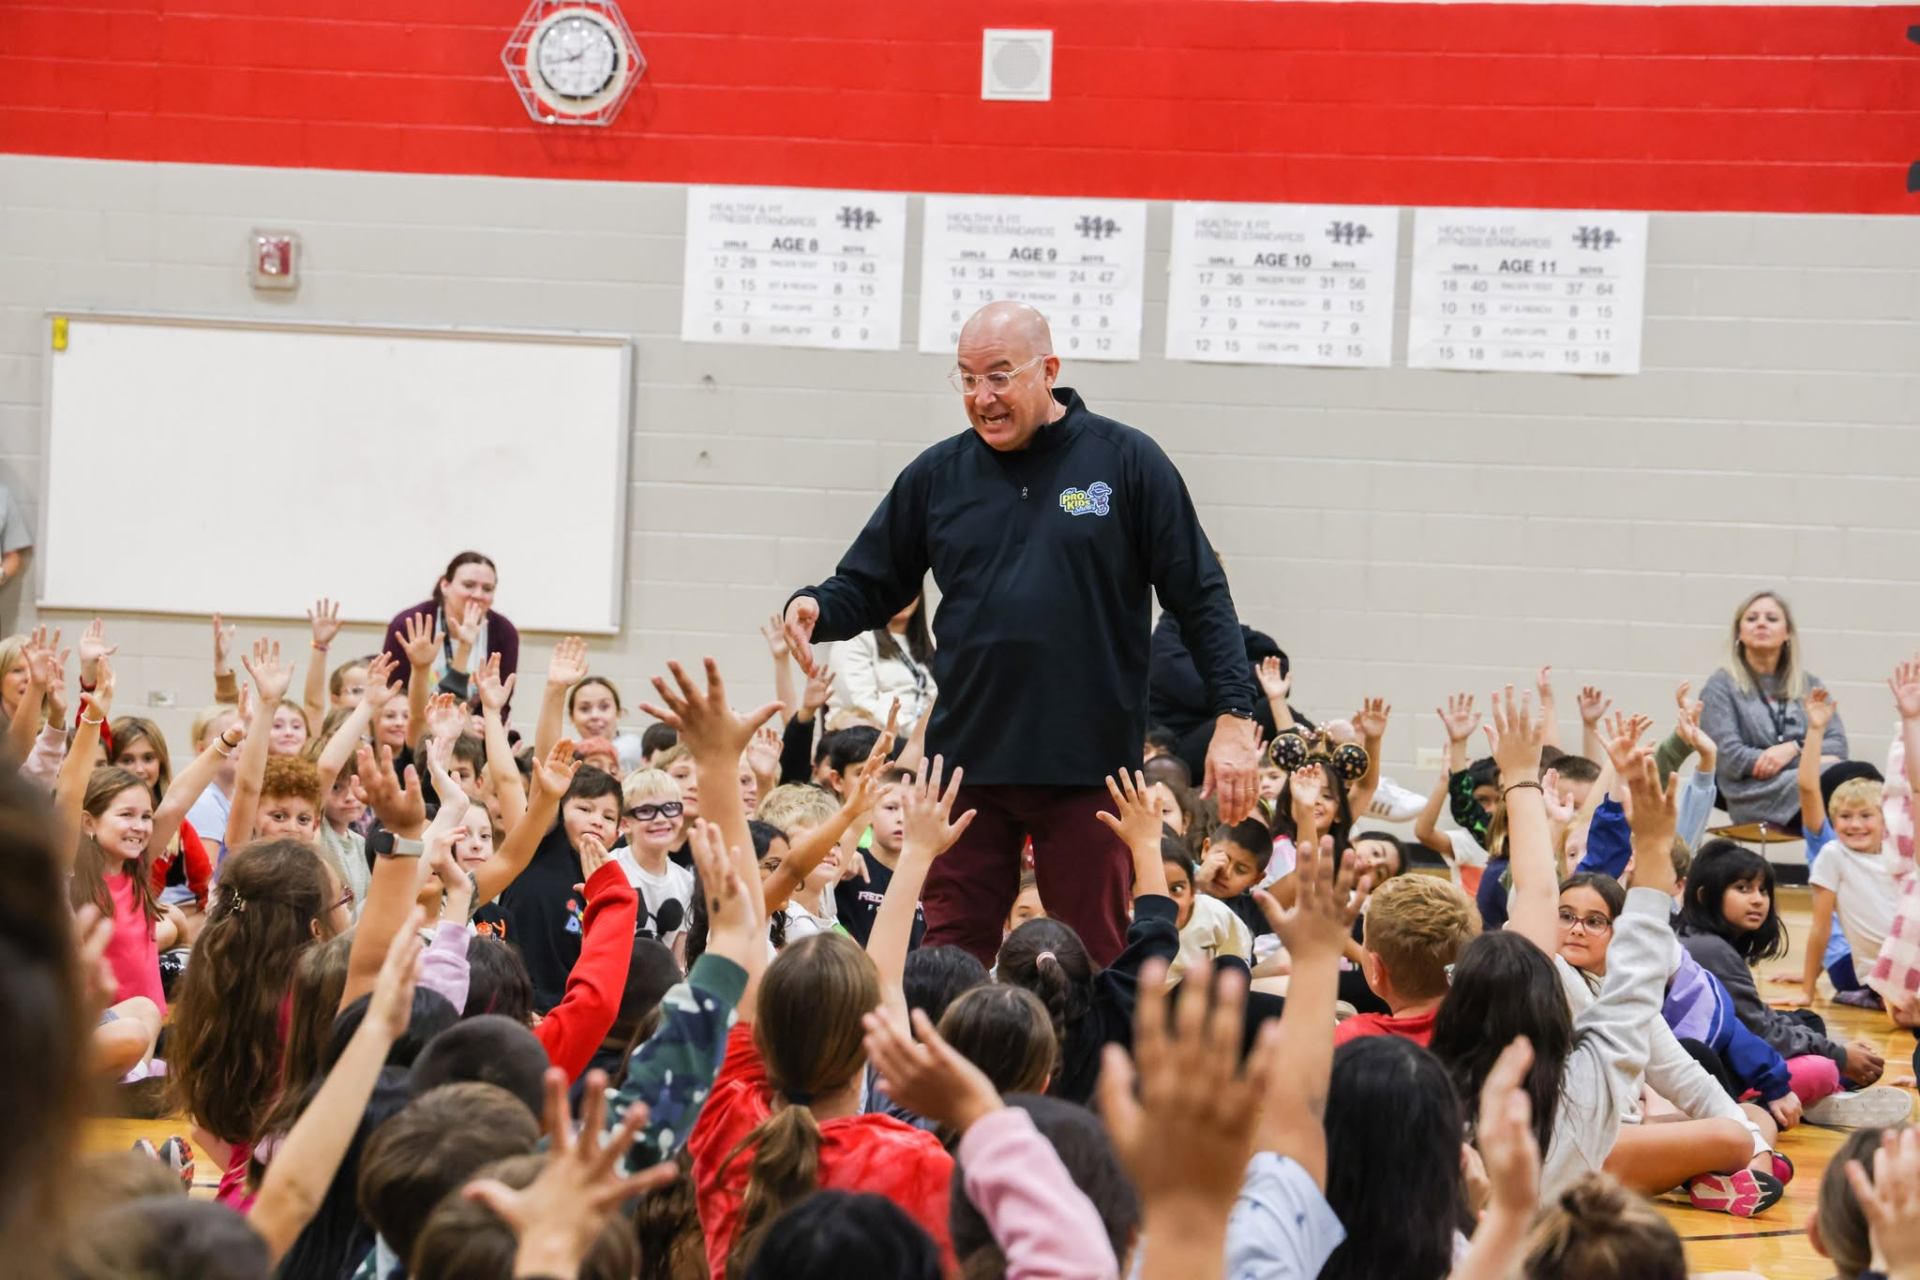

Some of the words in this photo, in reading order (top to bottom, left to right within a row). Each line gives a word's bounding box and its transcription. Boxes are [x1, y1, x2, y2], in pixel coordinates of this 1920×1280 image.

[772, 237, 804, 252] AGE
[809, 238, 819, 253] 8
[1010, 247, 1042, 262] AGE
[1047, 248, 1057, 262] 9
[1254, 253, 1288, 268] AGE
[1294, 254, 1312, 268] 10
[1498, 259, 1532, 274] AGE
[1541, 261, 1556, 273] 11
[1062, 492, 1084, 505] PRO
[1066, 500, 1090, 510] KIDS
